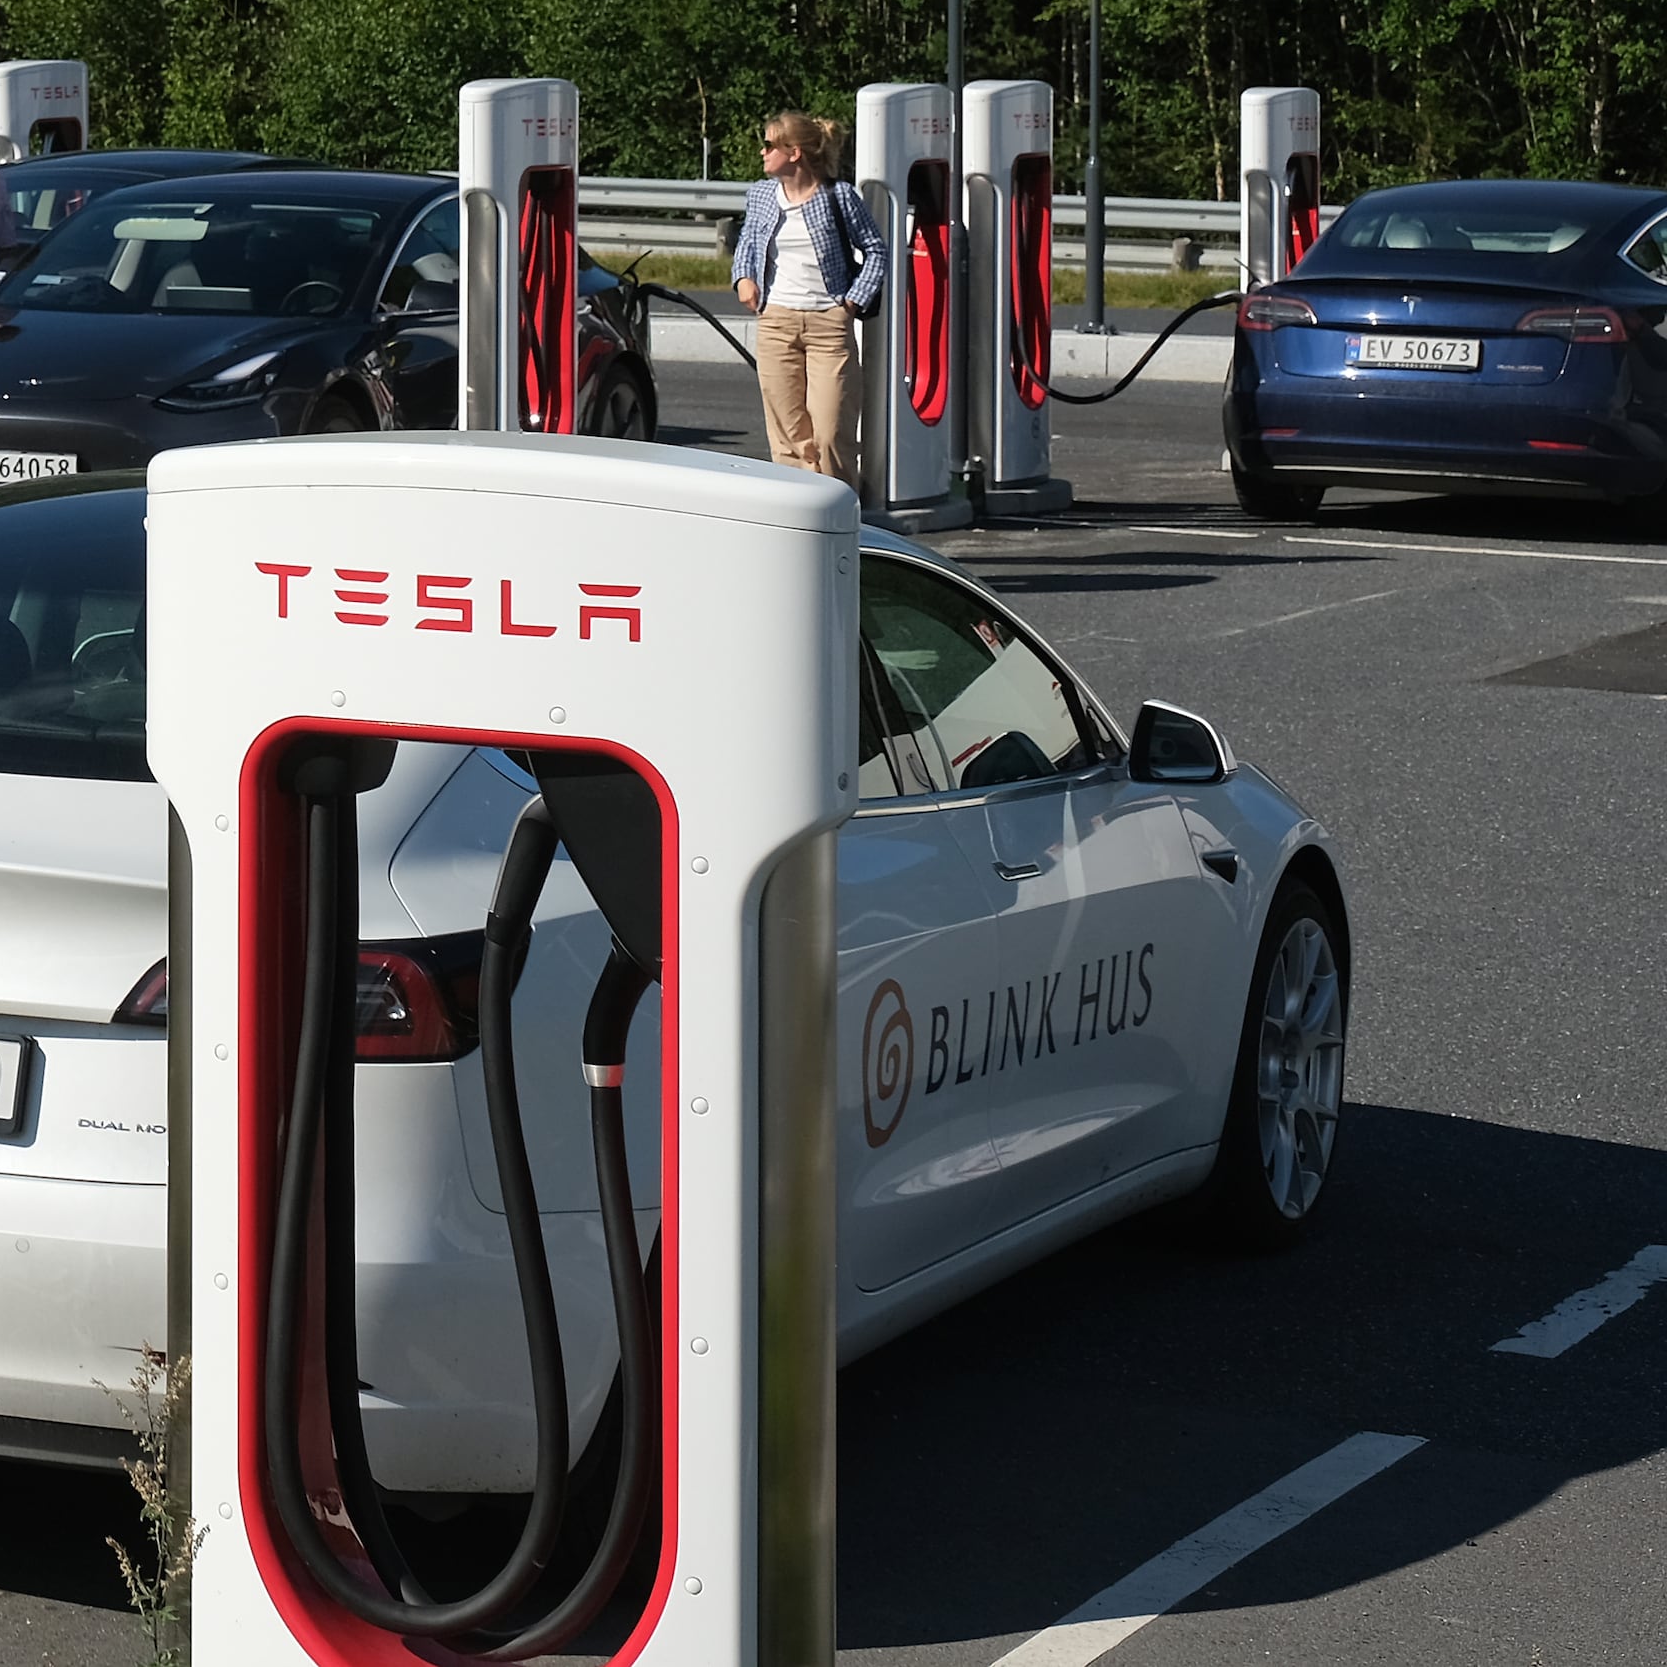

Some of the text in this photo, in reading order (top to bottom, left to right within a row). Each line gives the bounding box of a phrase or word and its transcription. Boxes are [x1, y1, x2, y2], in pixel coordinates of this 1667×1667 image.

[30, 85, 79, 100] TESLA
[1367, 339, 1470, 362] EV 50673
[0, 456, 69, 478] 64058
[254, 561, 642, 643] TESLA
[925, 942, 1154, 1095] BLINK HUS
[78, 1119, 130, 1132] DUAL
